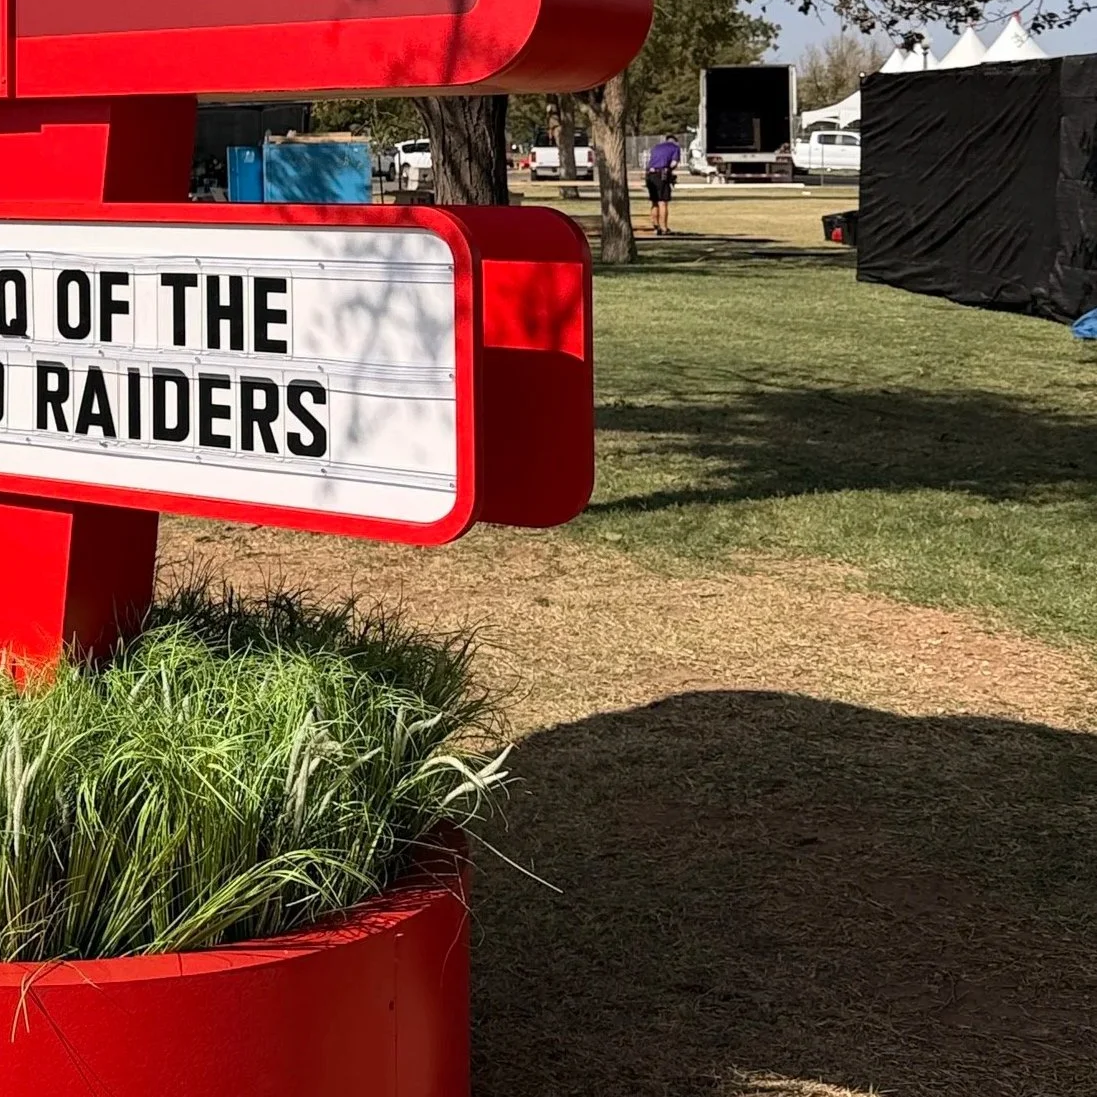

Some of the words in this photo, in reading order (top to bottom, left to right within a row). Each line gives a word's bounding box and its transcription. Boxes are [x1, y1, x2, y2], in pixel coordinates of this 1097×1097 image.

[56, 269, 130, 342] OF
[161, 273, 288, 354] THE
[36, 360, 327, 458] RAIDERS
